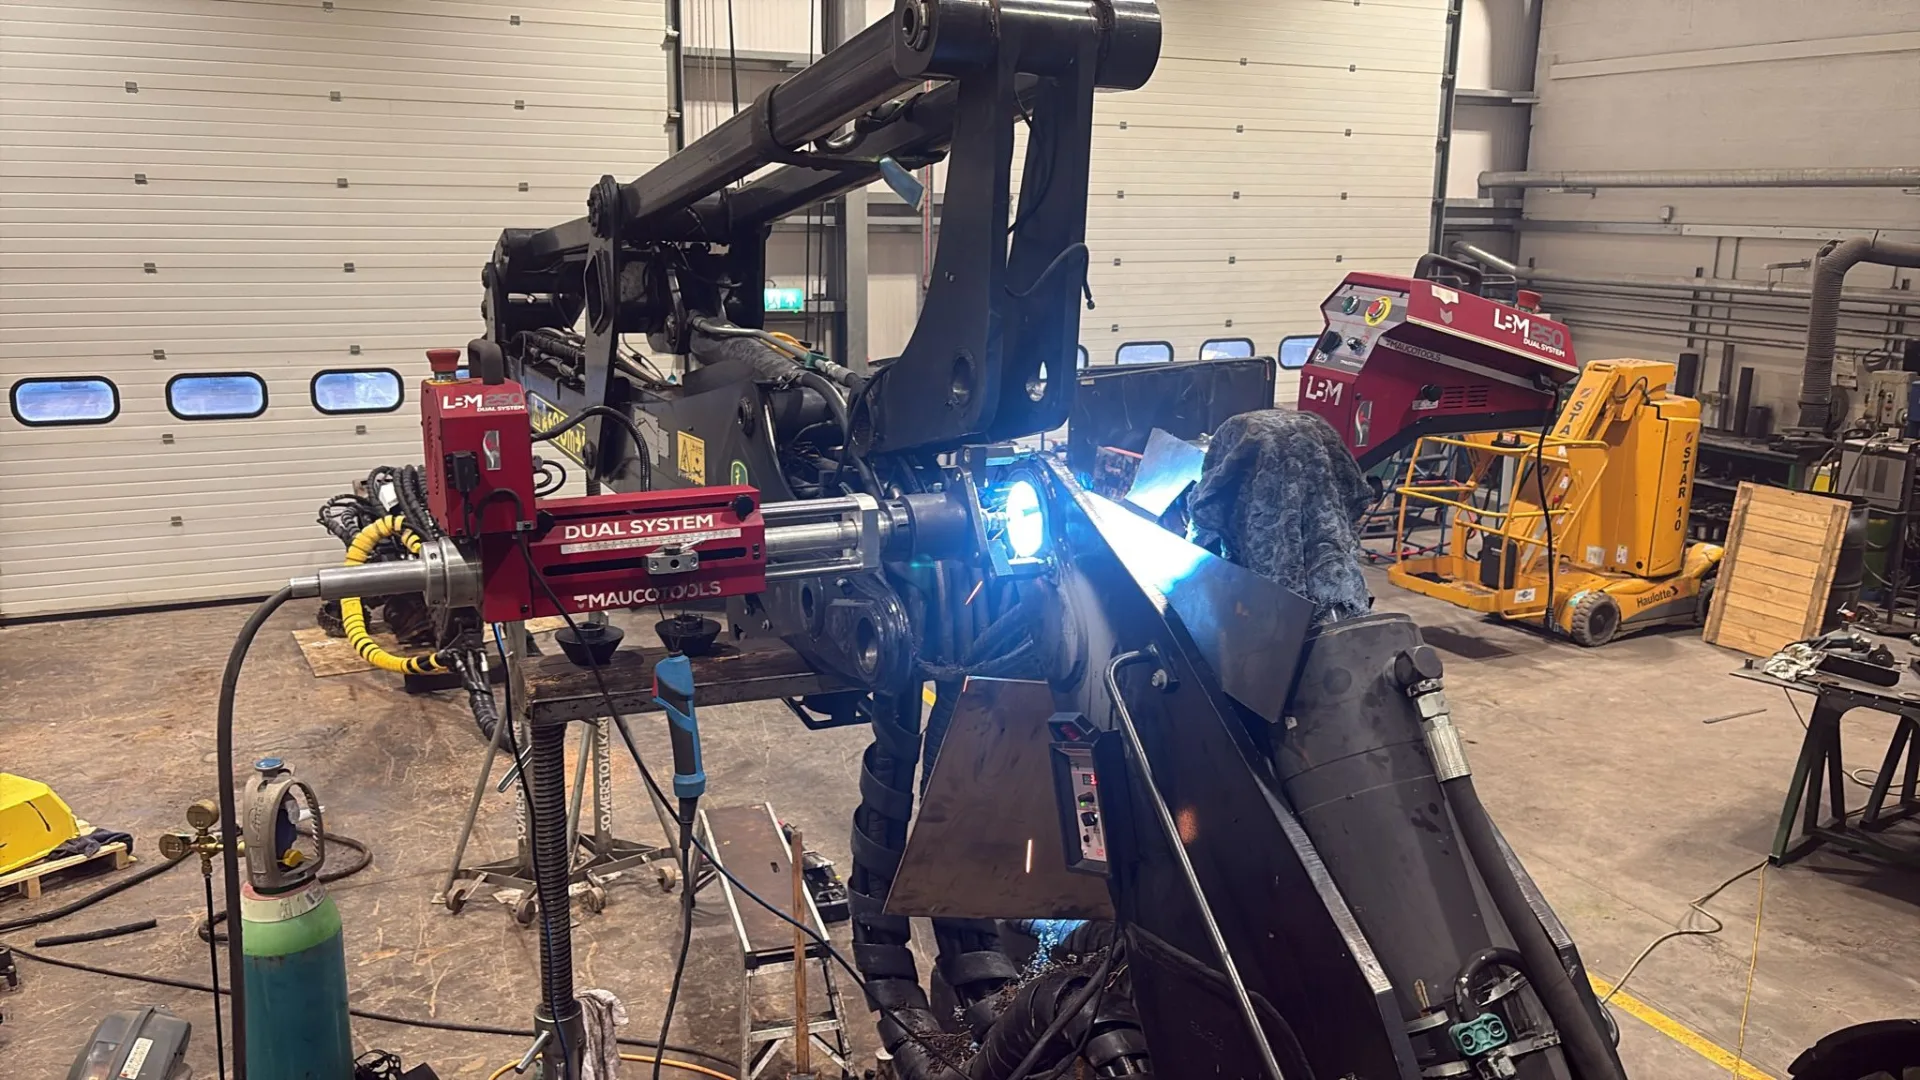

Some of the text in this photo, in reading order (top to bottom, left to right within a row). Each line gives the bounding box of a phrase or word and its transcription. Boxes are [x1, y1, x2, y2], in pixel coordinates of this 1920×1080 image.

[1494, 308, 1564, 348] LBM 250
[1523, 338, 1565, 357] DUAL SYSTEM
[443, 393, 523, 409] LBM 250
[1305, 375, 1343, 406] LBM
[1674, 446, 1691, 531] STAR 10
[564, 514, 714, 540] DUAL SYSTEM
[588, 580, 722, 609] MAUCOTOOLS
[1636, 588, 1671, 608] Haulotte
[597, 717, 611, 834] SOMERSTOTALKAR
